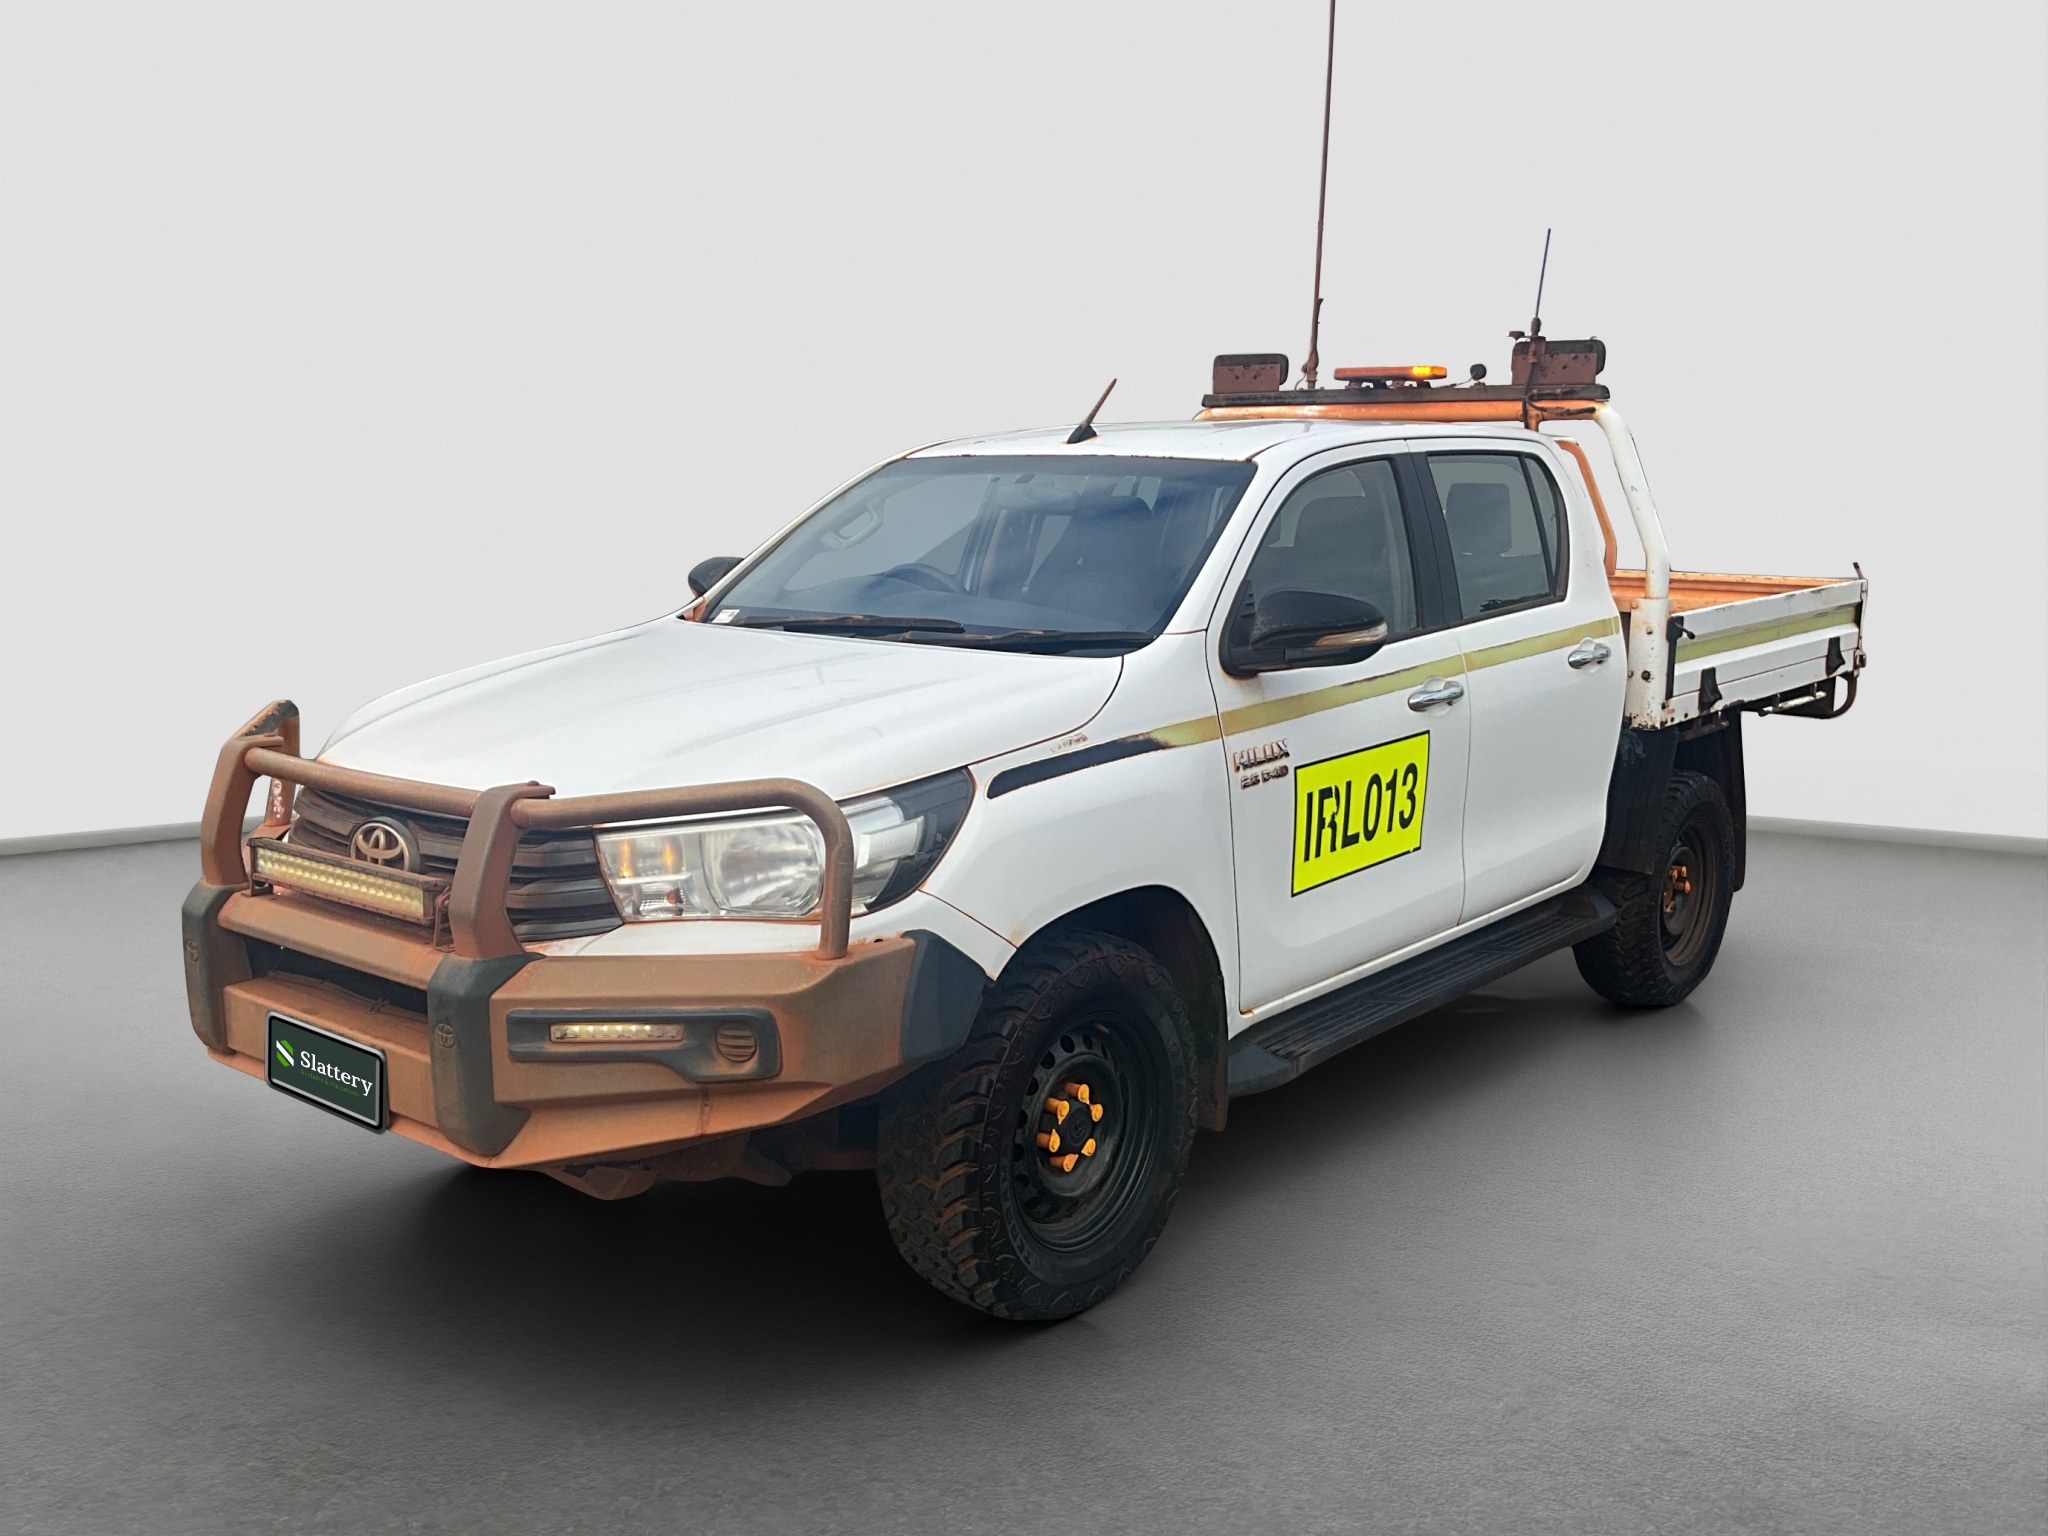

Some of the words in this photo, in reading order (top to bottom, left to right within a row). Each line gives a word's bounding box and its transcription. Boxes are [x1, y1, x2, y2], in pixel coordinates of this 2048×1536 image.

[1233, 738, 1290, 772] HILUX
[1304, 762, 1418, 862] IRL013
[300, 1050, 373, 1096] Slattery
